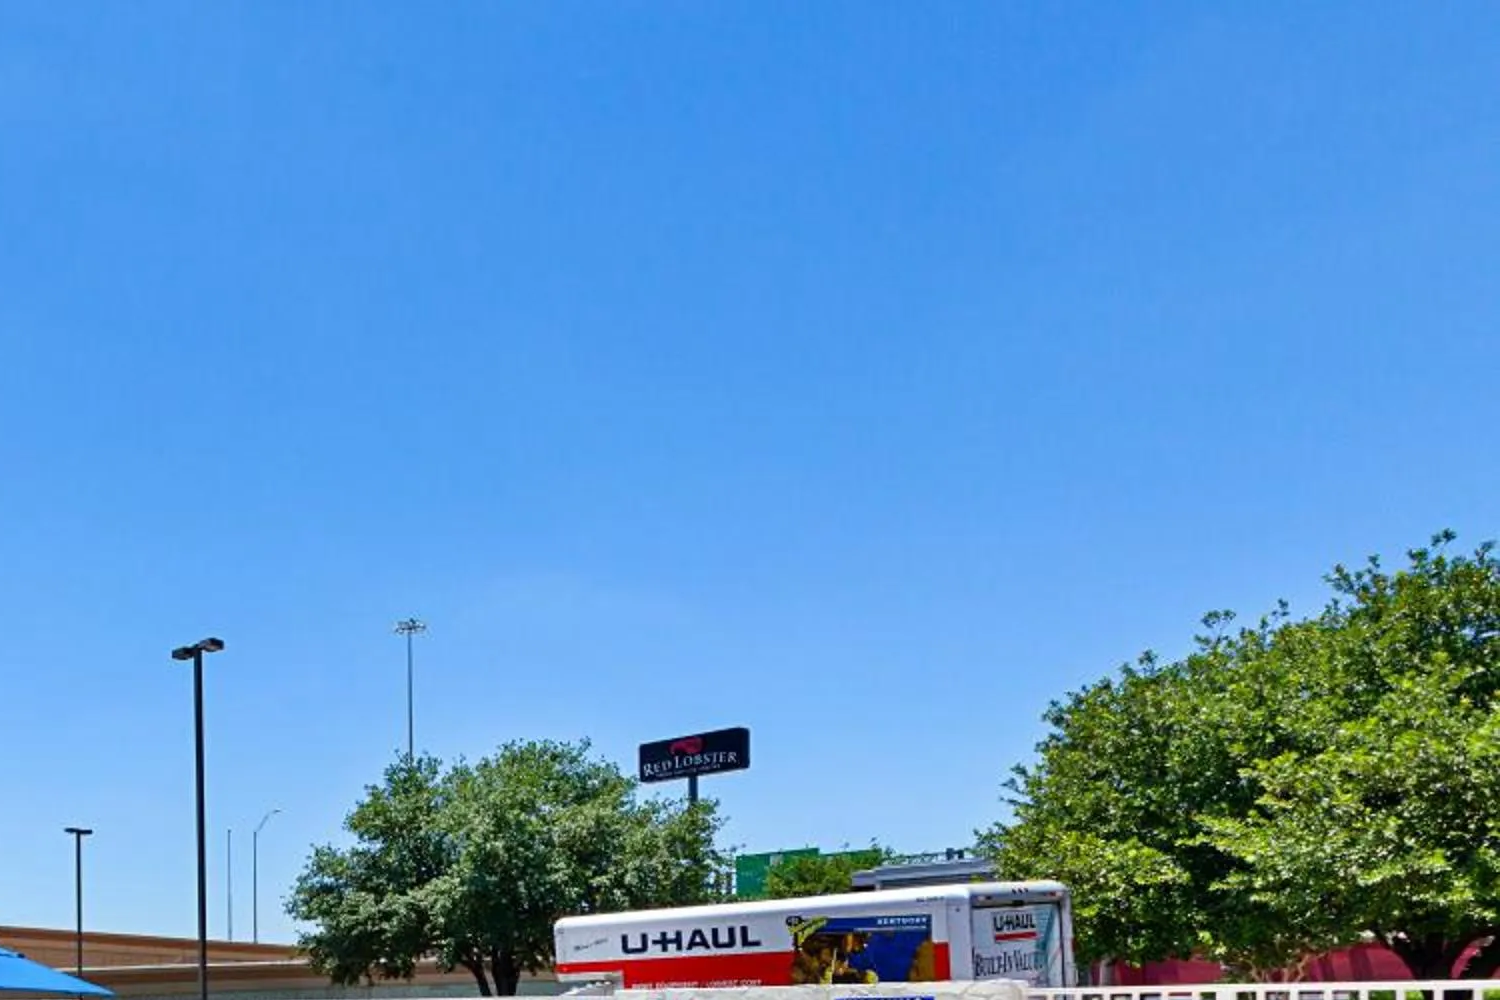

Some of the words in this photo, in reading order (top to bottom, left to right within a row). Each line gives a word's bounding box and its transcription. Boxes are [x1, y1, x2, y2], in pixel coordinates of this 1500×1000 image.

[643, 761, 672, 777] RED
[674, 751, 738, 769] LOBSTER
[621, 926, 762, 954] U-HAUL
